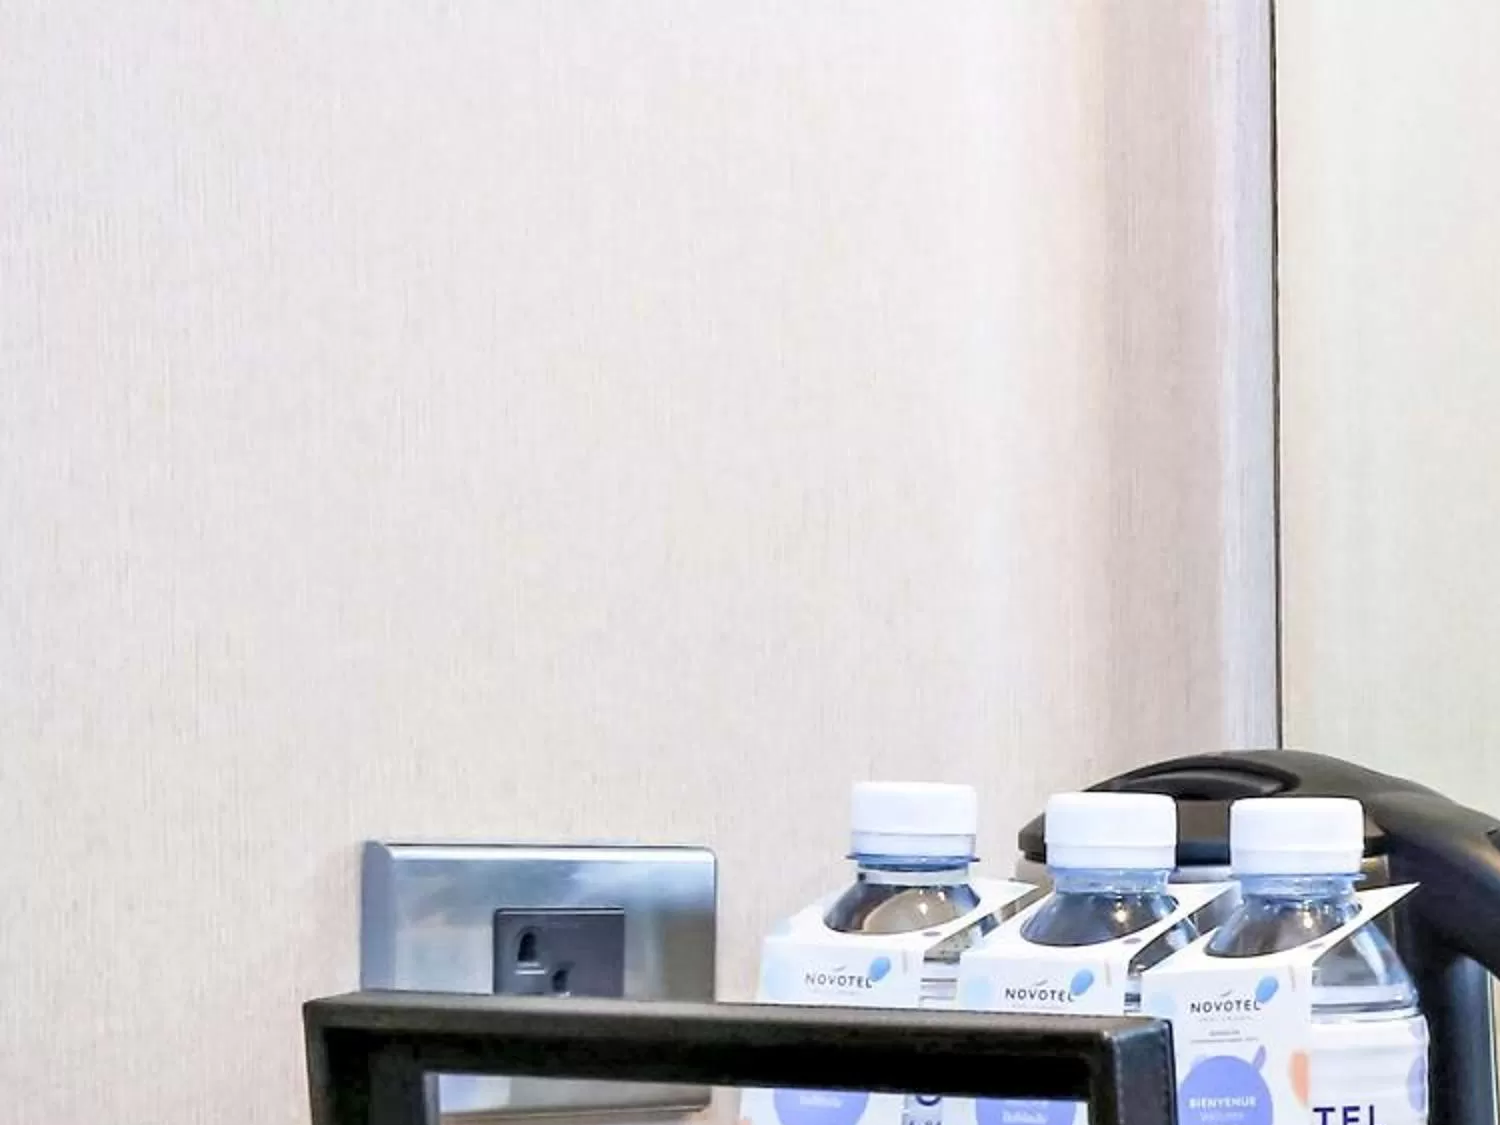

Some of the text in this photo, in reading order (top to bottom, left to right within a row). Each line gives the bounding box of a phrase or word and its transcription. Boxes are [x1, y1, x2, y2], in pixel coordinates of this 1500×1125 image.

[804, 972, 873, 990] NOVOTEL
[1004, 987, 1075, 1003] NOVOTEL
[1189, 999, 1261, 1014] NOVOTEL
